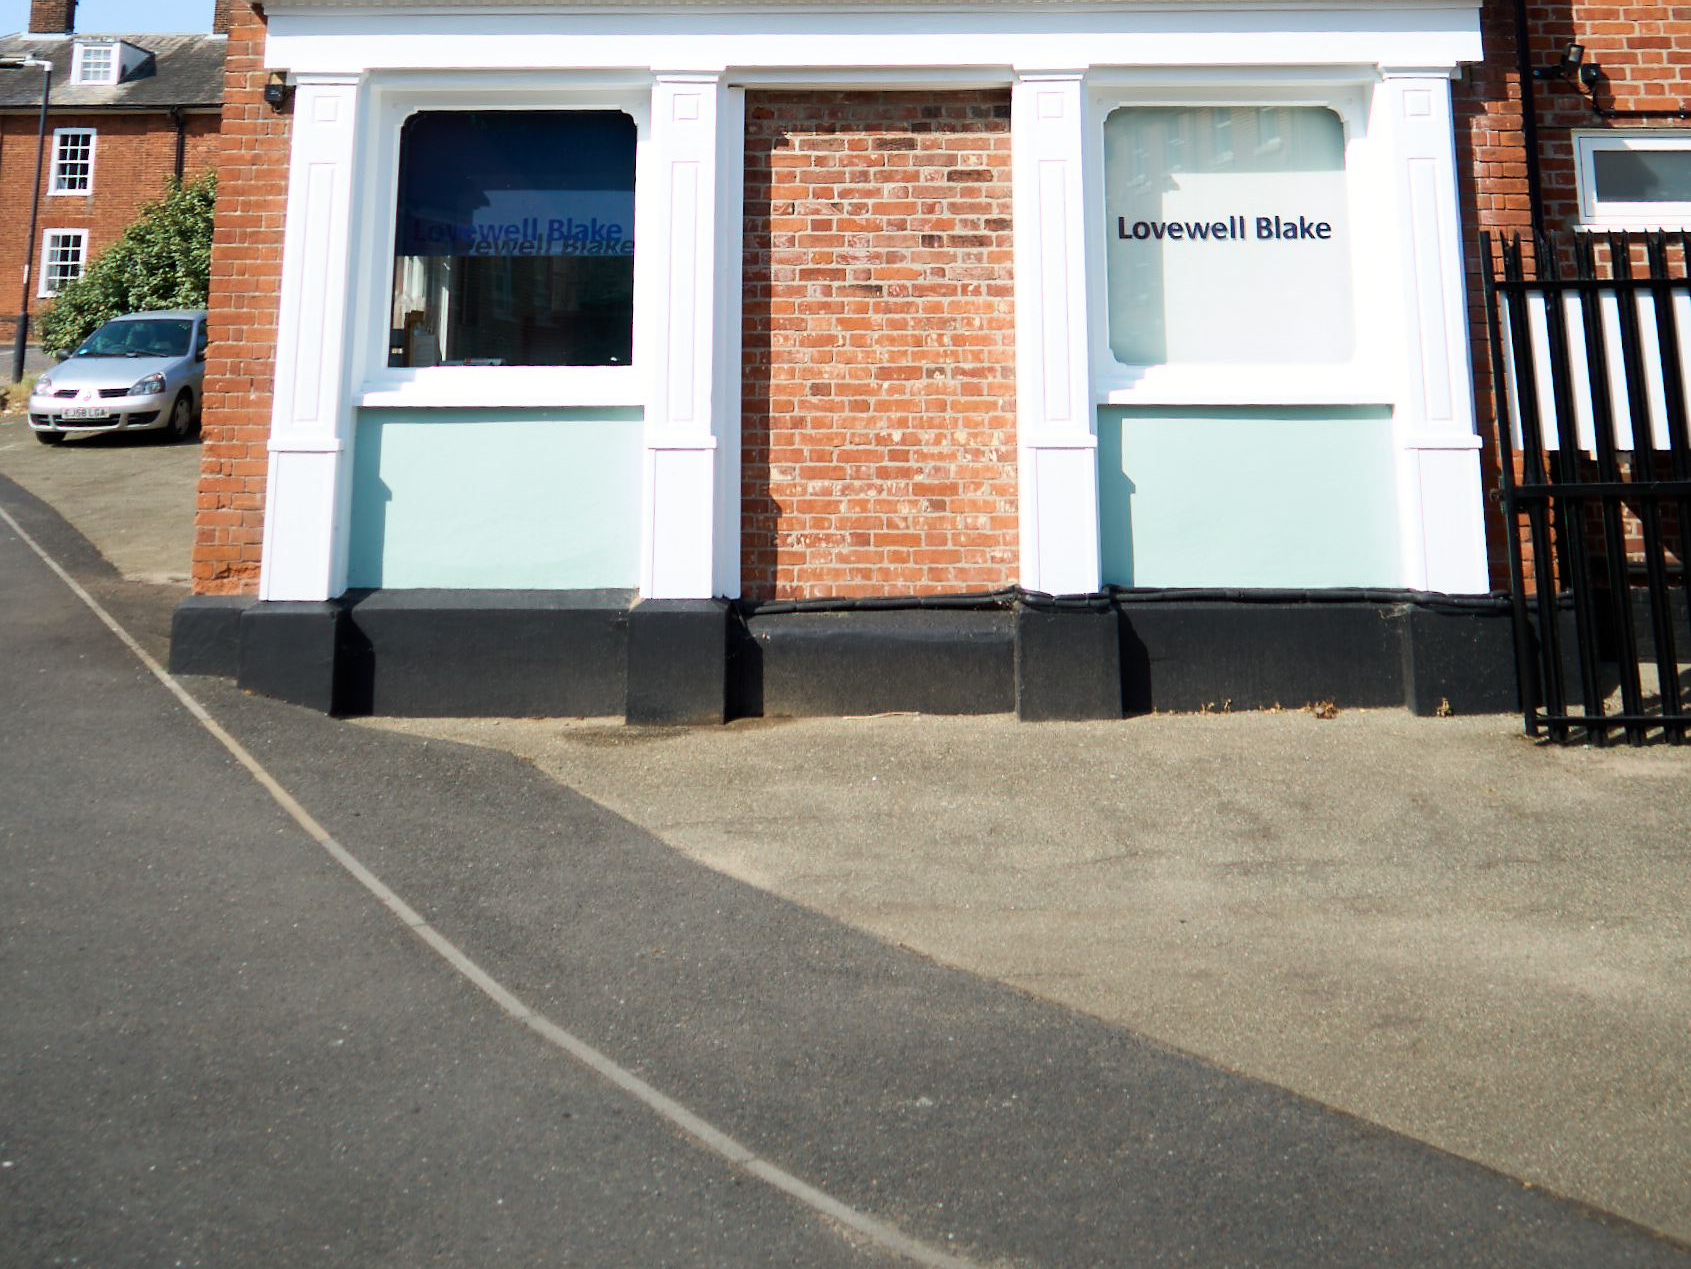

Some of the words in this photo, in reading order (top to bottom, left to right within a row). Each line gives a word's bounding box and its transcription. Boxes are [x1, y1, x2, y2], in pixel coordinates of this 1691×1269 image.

[413, 217, 538, 243] Lovewell
[547, 217, 623, 242] Blake
[1117, 215, 1245, 240] Lovewell
[1255, 215, 1332, 240] Blake
